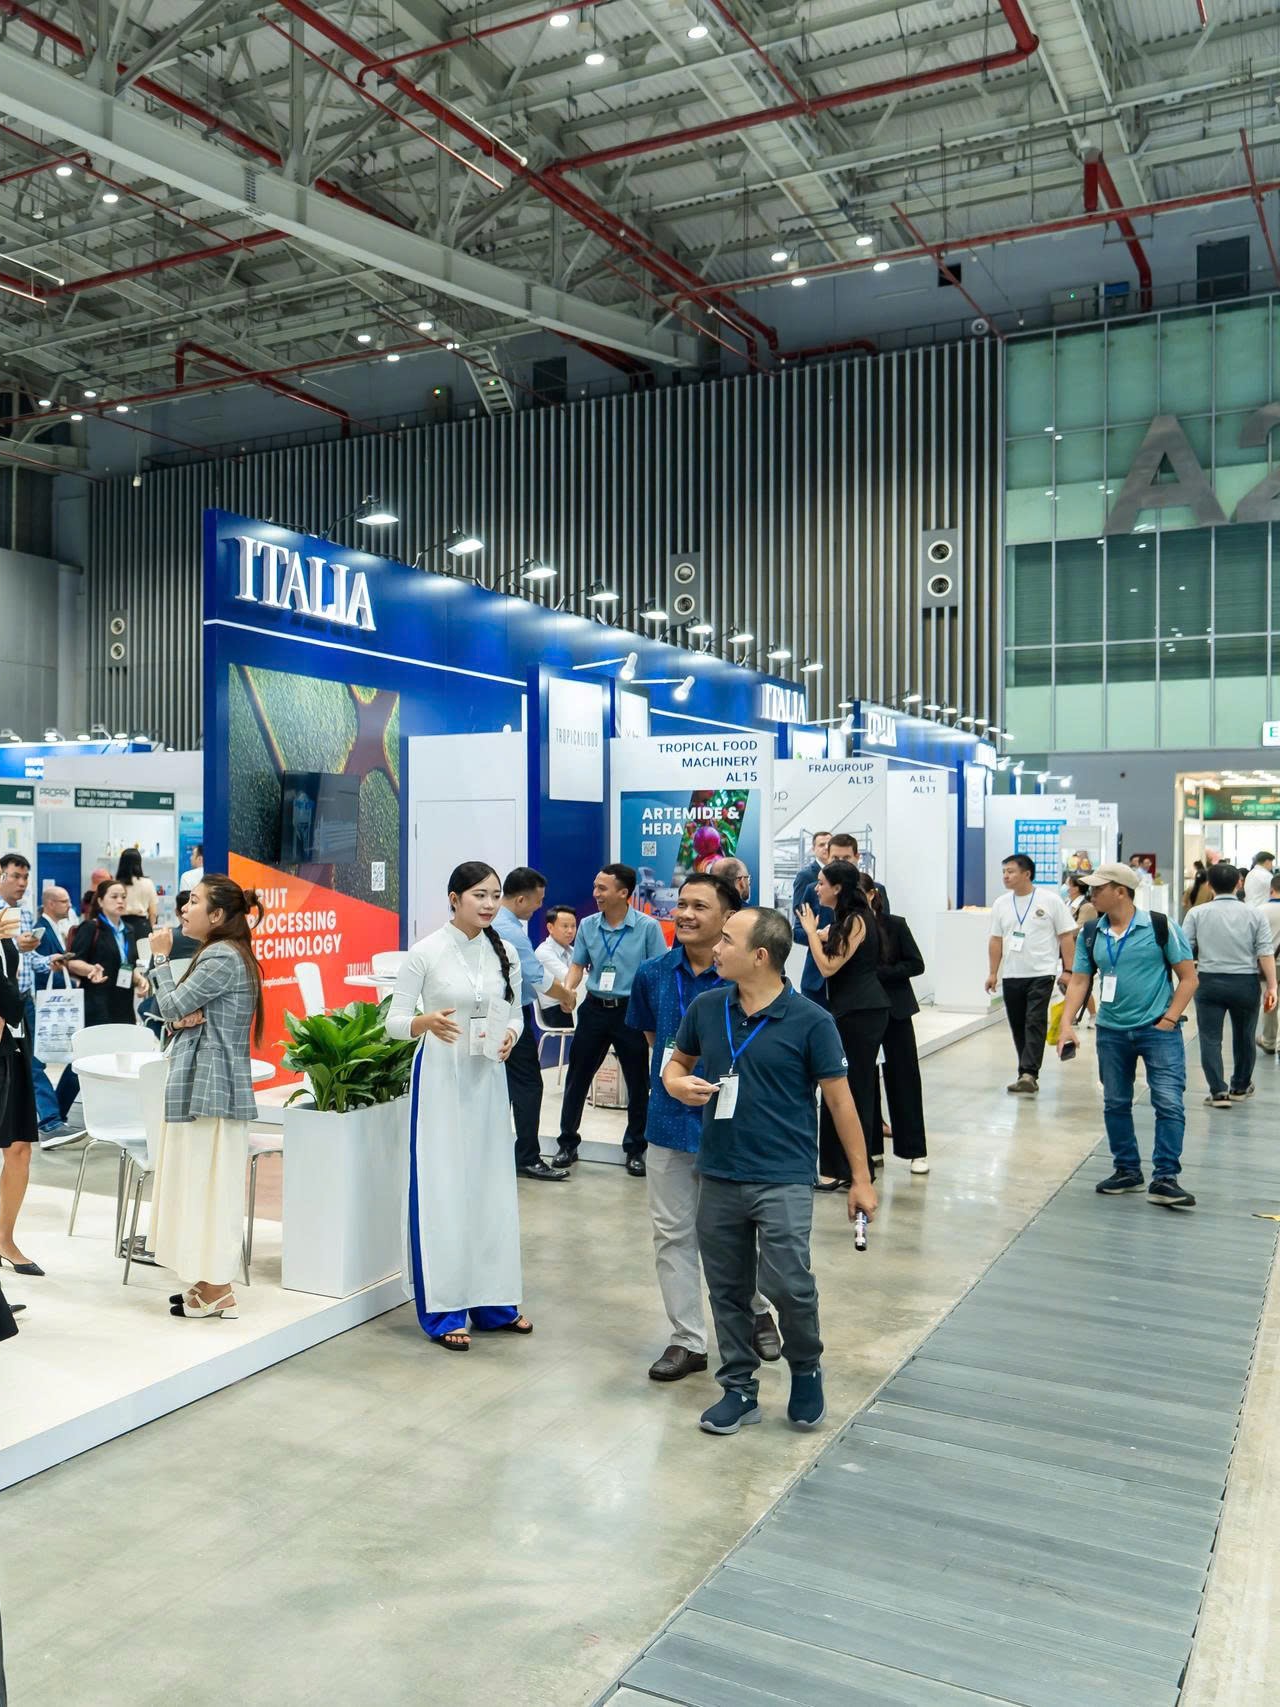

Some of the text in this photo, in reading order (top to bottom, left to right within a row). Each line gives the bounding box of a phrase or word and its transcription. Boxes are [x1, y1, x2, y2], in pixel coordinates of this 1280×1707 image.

[232, 535, 376, 631] ITALIA
[761, 683, 807, 725] ITALIA
[657, 740, 758, 753] TROPICAL FOOD
[682, 756, 757, 768] MACHINERY
[808, 762, 874, 774] FRAUGROUP
[725, 772, 758, 782] AL15
[848, 776, 874, 785] AL13
[642, 807, 740, 821] ARTEMIDE &
[642, 822, 683, 836] HERA
[254, 888, 288, 909] RUIT
